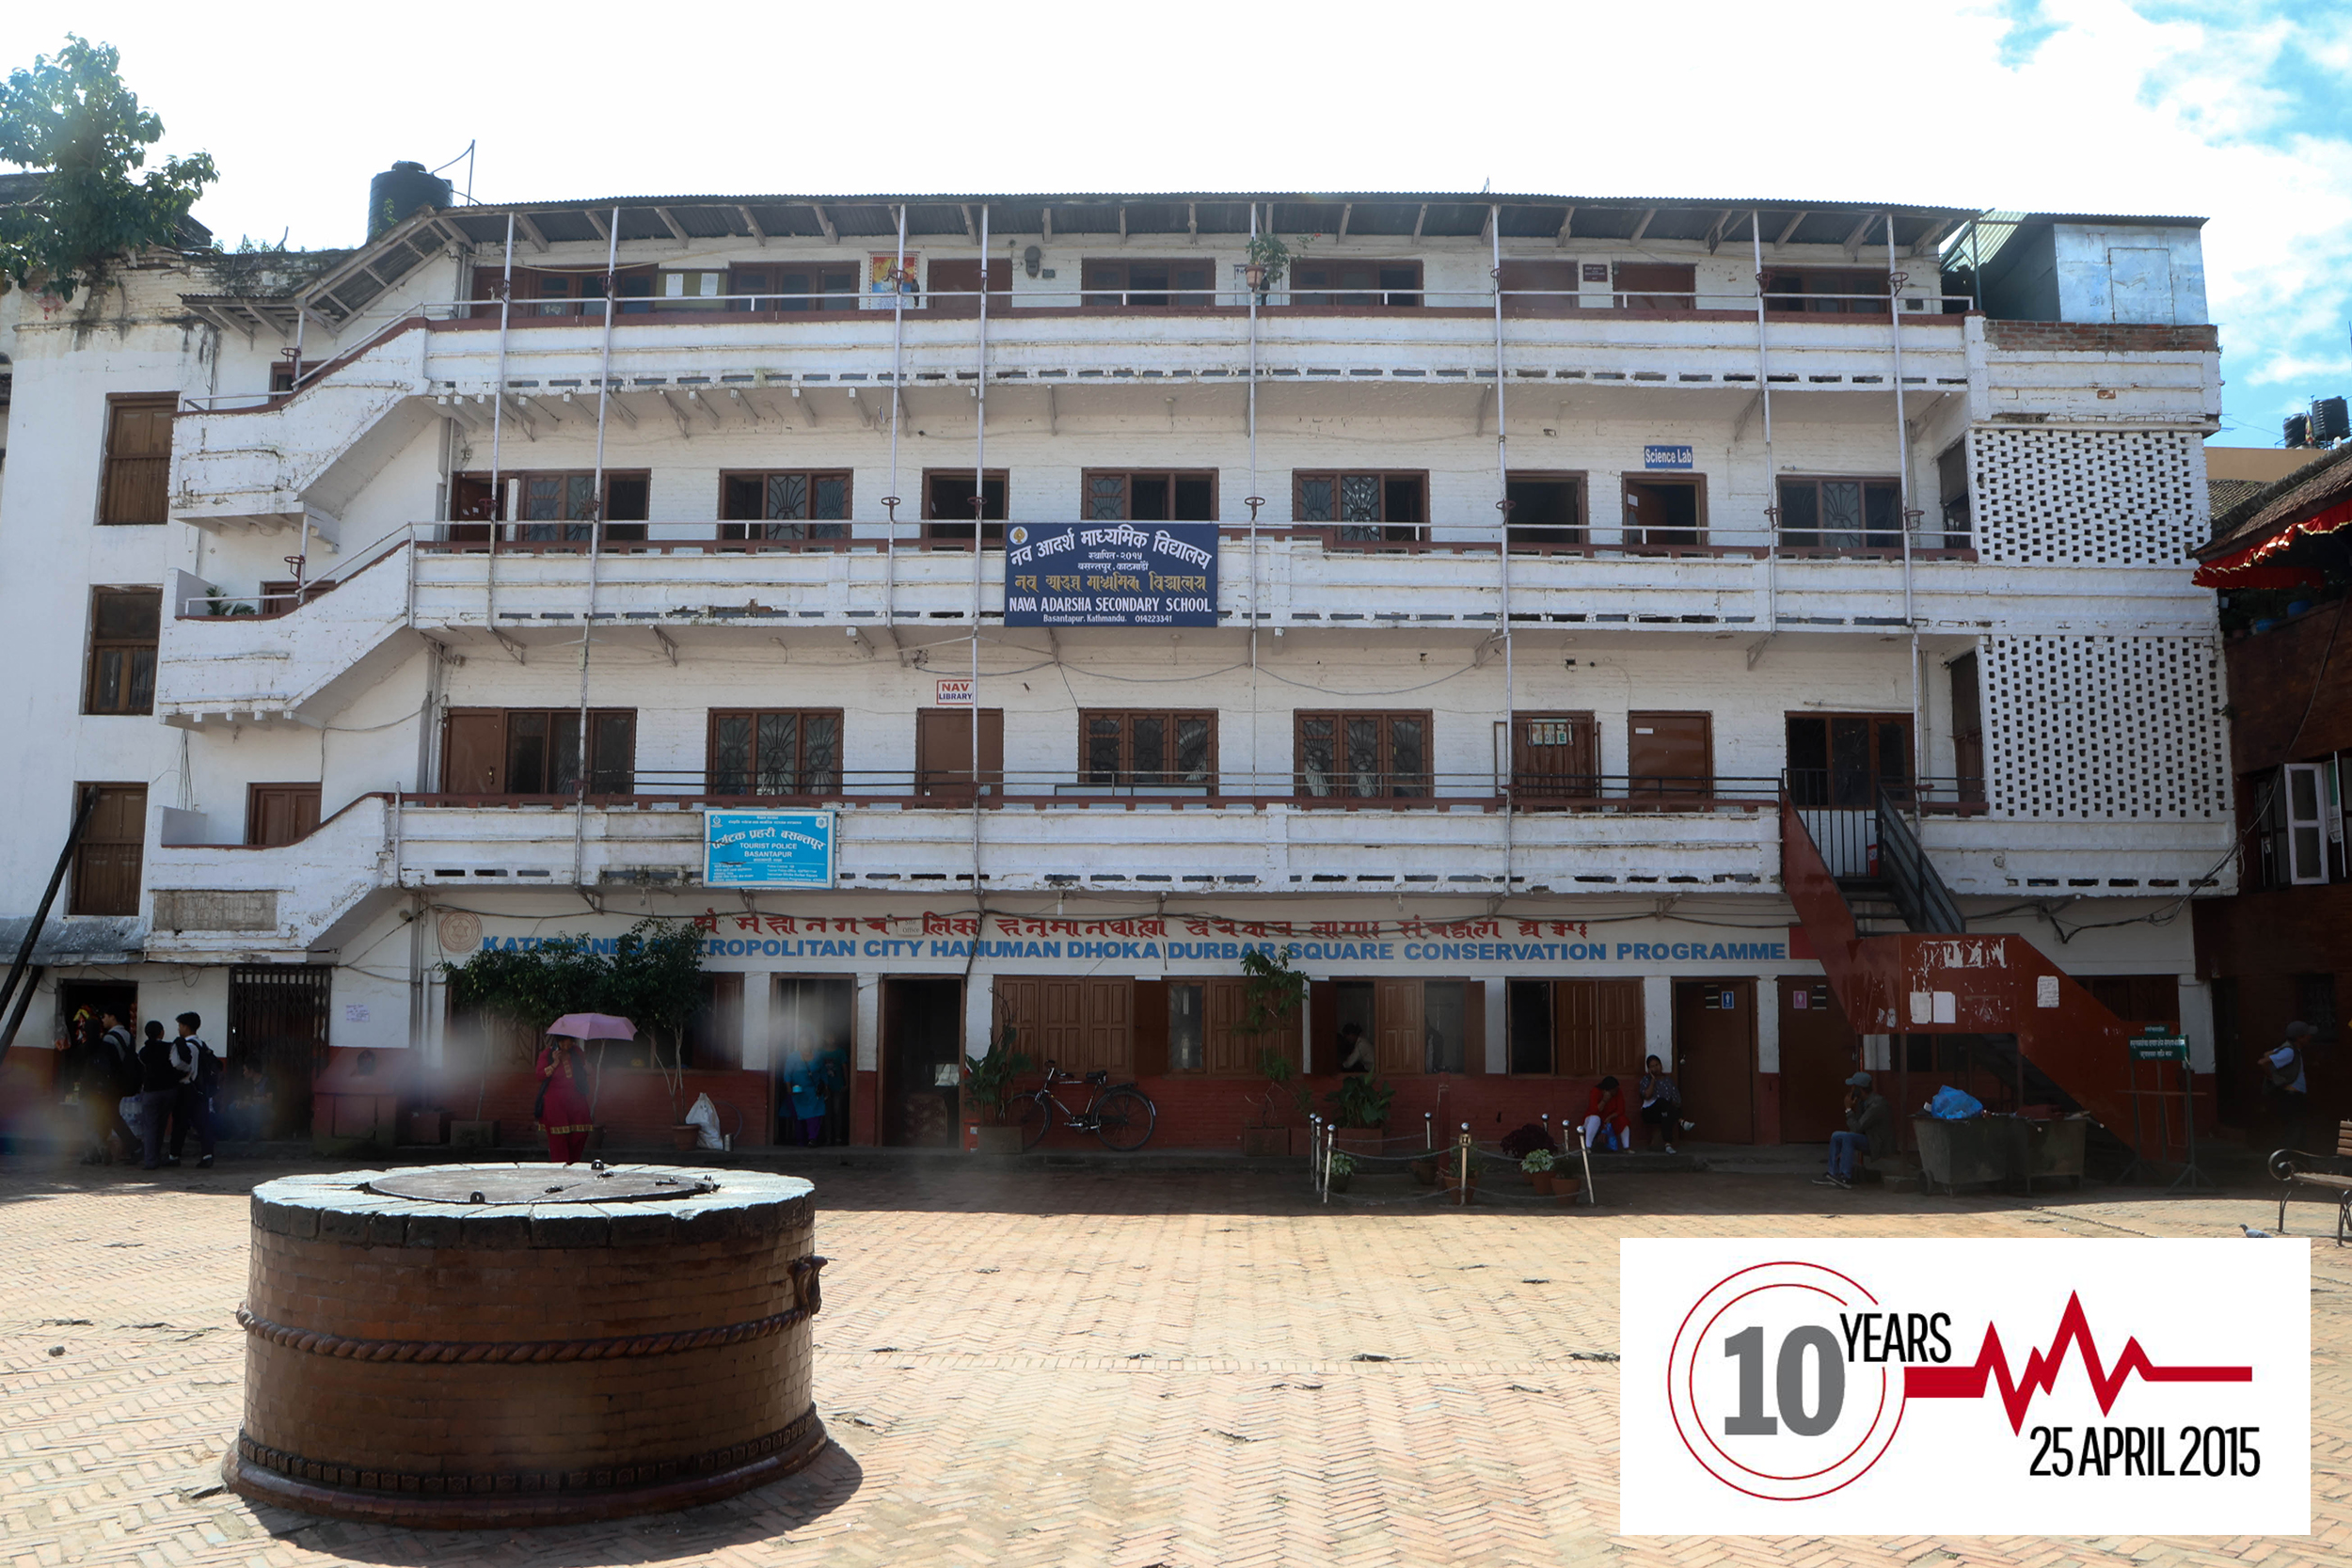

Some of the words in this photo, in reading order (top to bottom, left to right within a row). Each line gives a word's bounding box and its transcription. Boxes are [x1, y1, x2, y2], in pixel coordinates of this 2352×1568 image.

[1645, 448, 1676, 463] Science
[1677, 449, 1692, 463] Lab
[1009, 545, 1033, 566] नव
[1036, 528, 1075, 558] आदर्श
[1080, 524, 1150, 548] माध्यमिक
[1152, 530, 1213, 570] विद्यालय
[1009, 597, 1037, 612] NAVA
[1041, 597, 1092, 612] ADARSHA
[1095, 597, 1160, 612] SECONDARY
[1166, 597, 1212, 612] SCHOOL
[942, 683, 969, 691] NAV
[651, 939, 856, 957] TROPOLITAN
[864, 940, 924, 957] CITY
[930, 940, 1061, 958] HANUMAN
[1067, 941, 1161, 958] DHOKA
[1168, 942, 1278, 959] DURBAR
[1286, 942, 1394, 959] SQUARE
[1406, 942, 1606, 960] CONSERVATION
[1616, 942, 1785, 959] PROGRAMME
